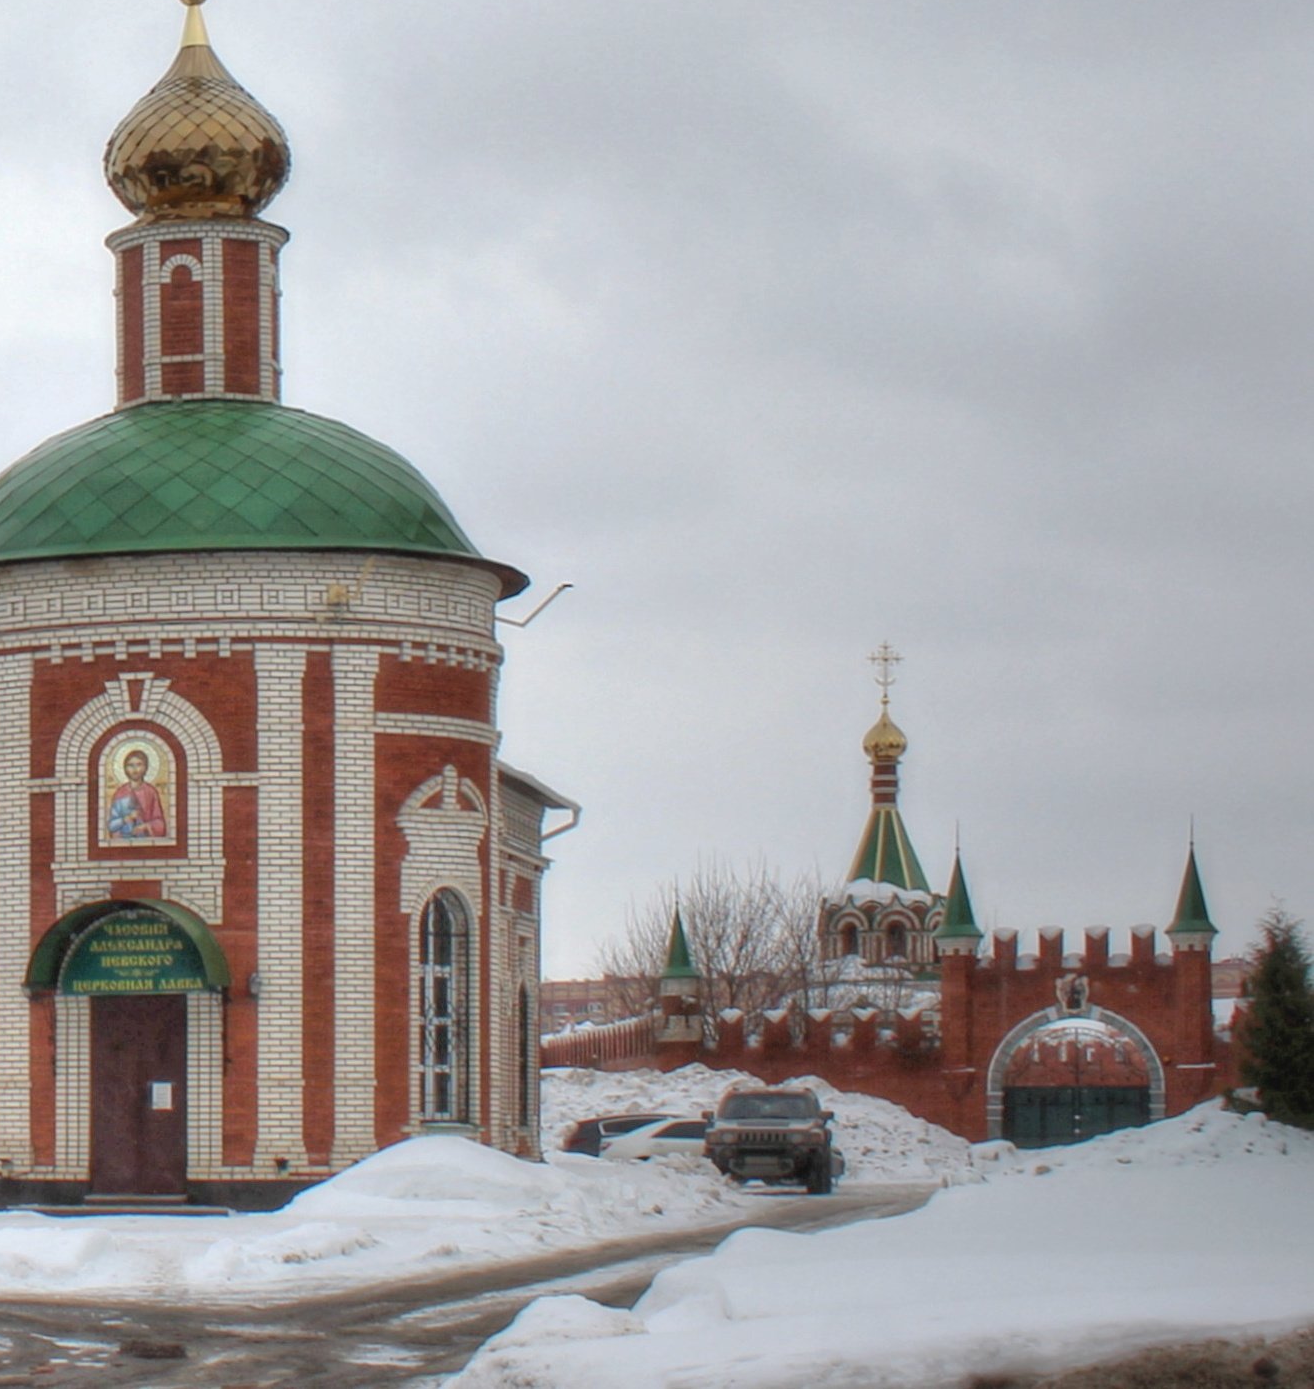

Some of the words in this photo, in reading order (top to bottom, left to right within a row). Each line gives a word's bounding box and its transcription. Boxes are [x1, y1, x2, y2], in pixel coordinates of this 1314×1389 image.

[100, 954, 174, 968] НЕВСКОГО
[73, 979, 154, 993] ЦЕРКОВНАЯ
[158, 977, 204, 991] ЛАВКА
